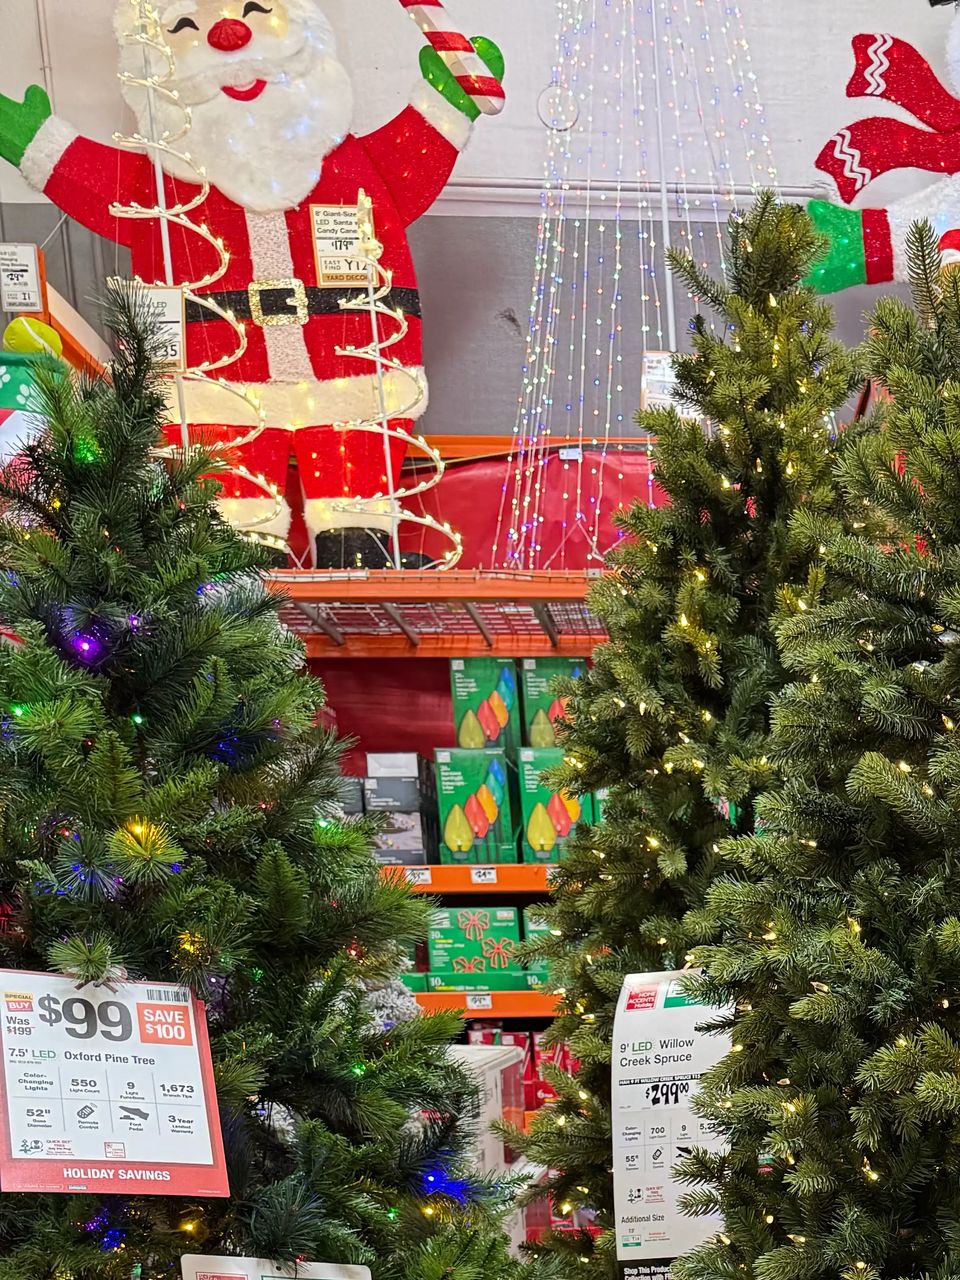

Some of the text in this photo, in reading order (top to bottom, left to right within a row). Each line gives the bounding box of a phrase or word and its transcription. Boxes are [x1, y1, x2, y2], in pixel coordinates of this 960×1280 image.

[9, 1001, 30, 1009] BUY
[6, 1015, 30, 1026] Was
[38, 993, 133, 1042] $99
[143, 1009, 184, 1023] SAVE
[7, 1026, 32, 1035] $199
[145, 1023, 186, 1040] $100
[620, 1039, 694, 1053] 9' LED Willow
[8, 1048, 156, 1065] 7.5' LED Oxford Pine Tree
[620, 1053, 692, 1067] Creek Spruce
[71, 1079, 97, 1087] 550
[127, 1081, 136, 1090] 9
[160, 1084, 194, 1093] 1,673
[168, 1115, 176, 1123] 3
[63, 1168, 171, 1181] HOLIDAY SAVINGS
[621, 1213, 664, 1223] Additional Size
[624, 1267, 638, 1275] Shop
